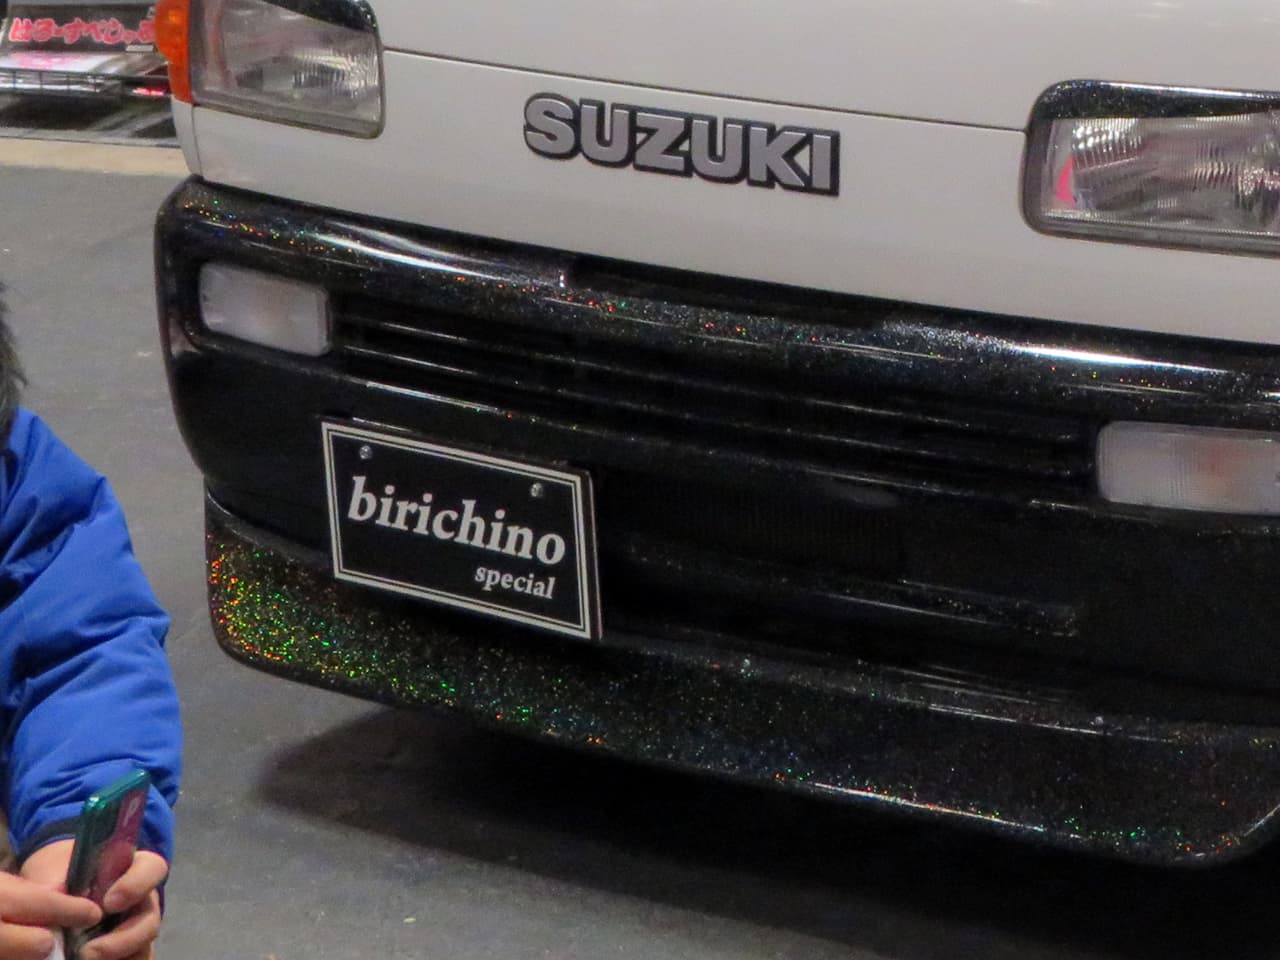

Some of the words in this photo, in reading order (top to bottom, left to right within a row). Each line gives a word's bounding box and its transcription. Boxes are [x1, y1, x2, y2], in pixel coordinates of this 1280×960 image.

[523, 92, 840, 197] SUZUKI
[347, 475, 566, 566] birichino
[474, 565, 557, 600] special
